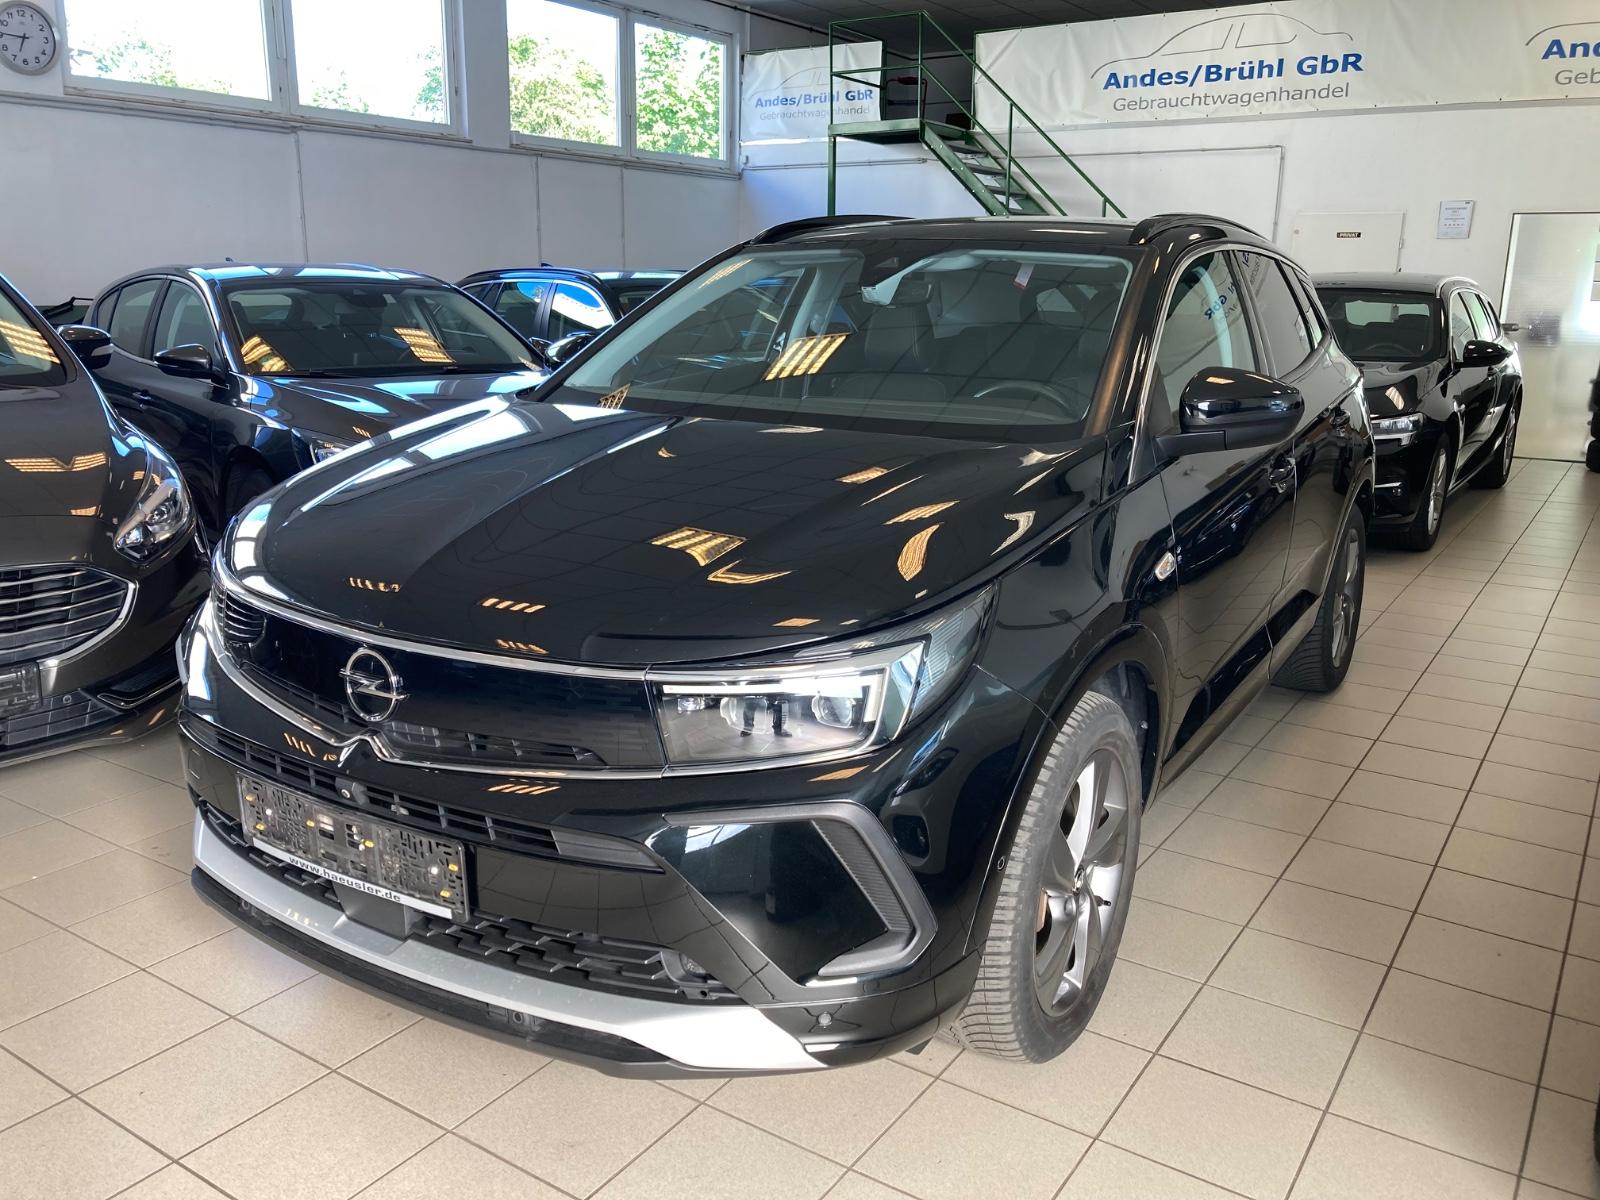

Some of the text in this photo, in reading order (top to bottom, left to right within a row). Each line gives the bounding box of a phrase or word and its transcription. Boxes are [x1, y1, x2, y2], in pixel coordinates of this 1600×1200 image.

[16, 9, 26, 17] 12
[35, 56, 40, 64] 5
[1103, 53, 1364, 90] Andes/Brühl GbR
[845, 89, 873, 101] GbR
[1113, 82, 1349, 112] Gebrauchtwagenhandel
[289, 857, 401, 902] www.haeusler.de
